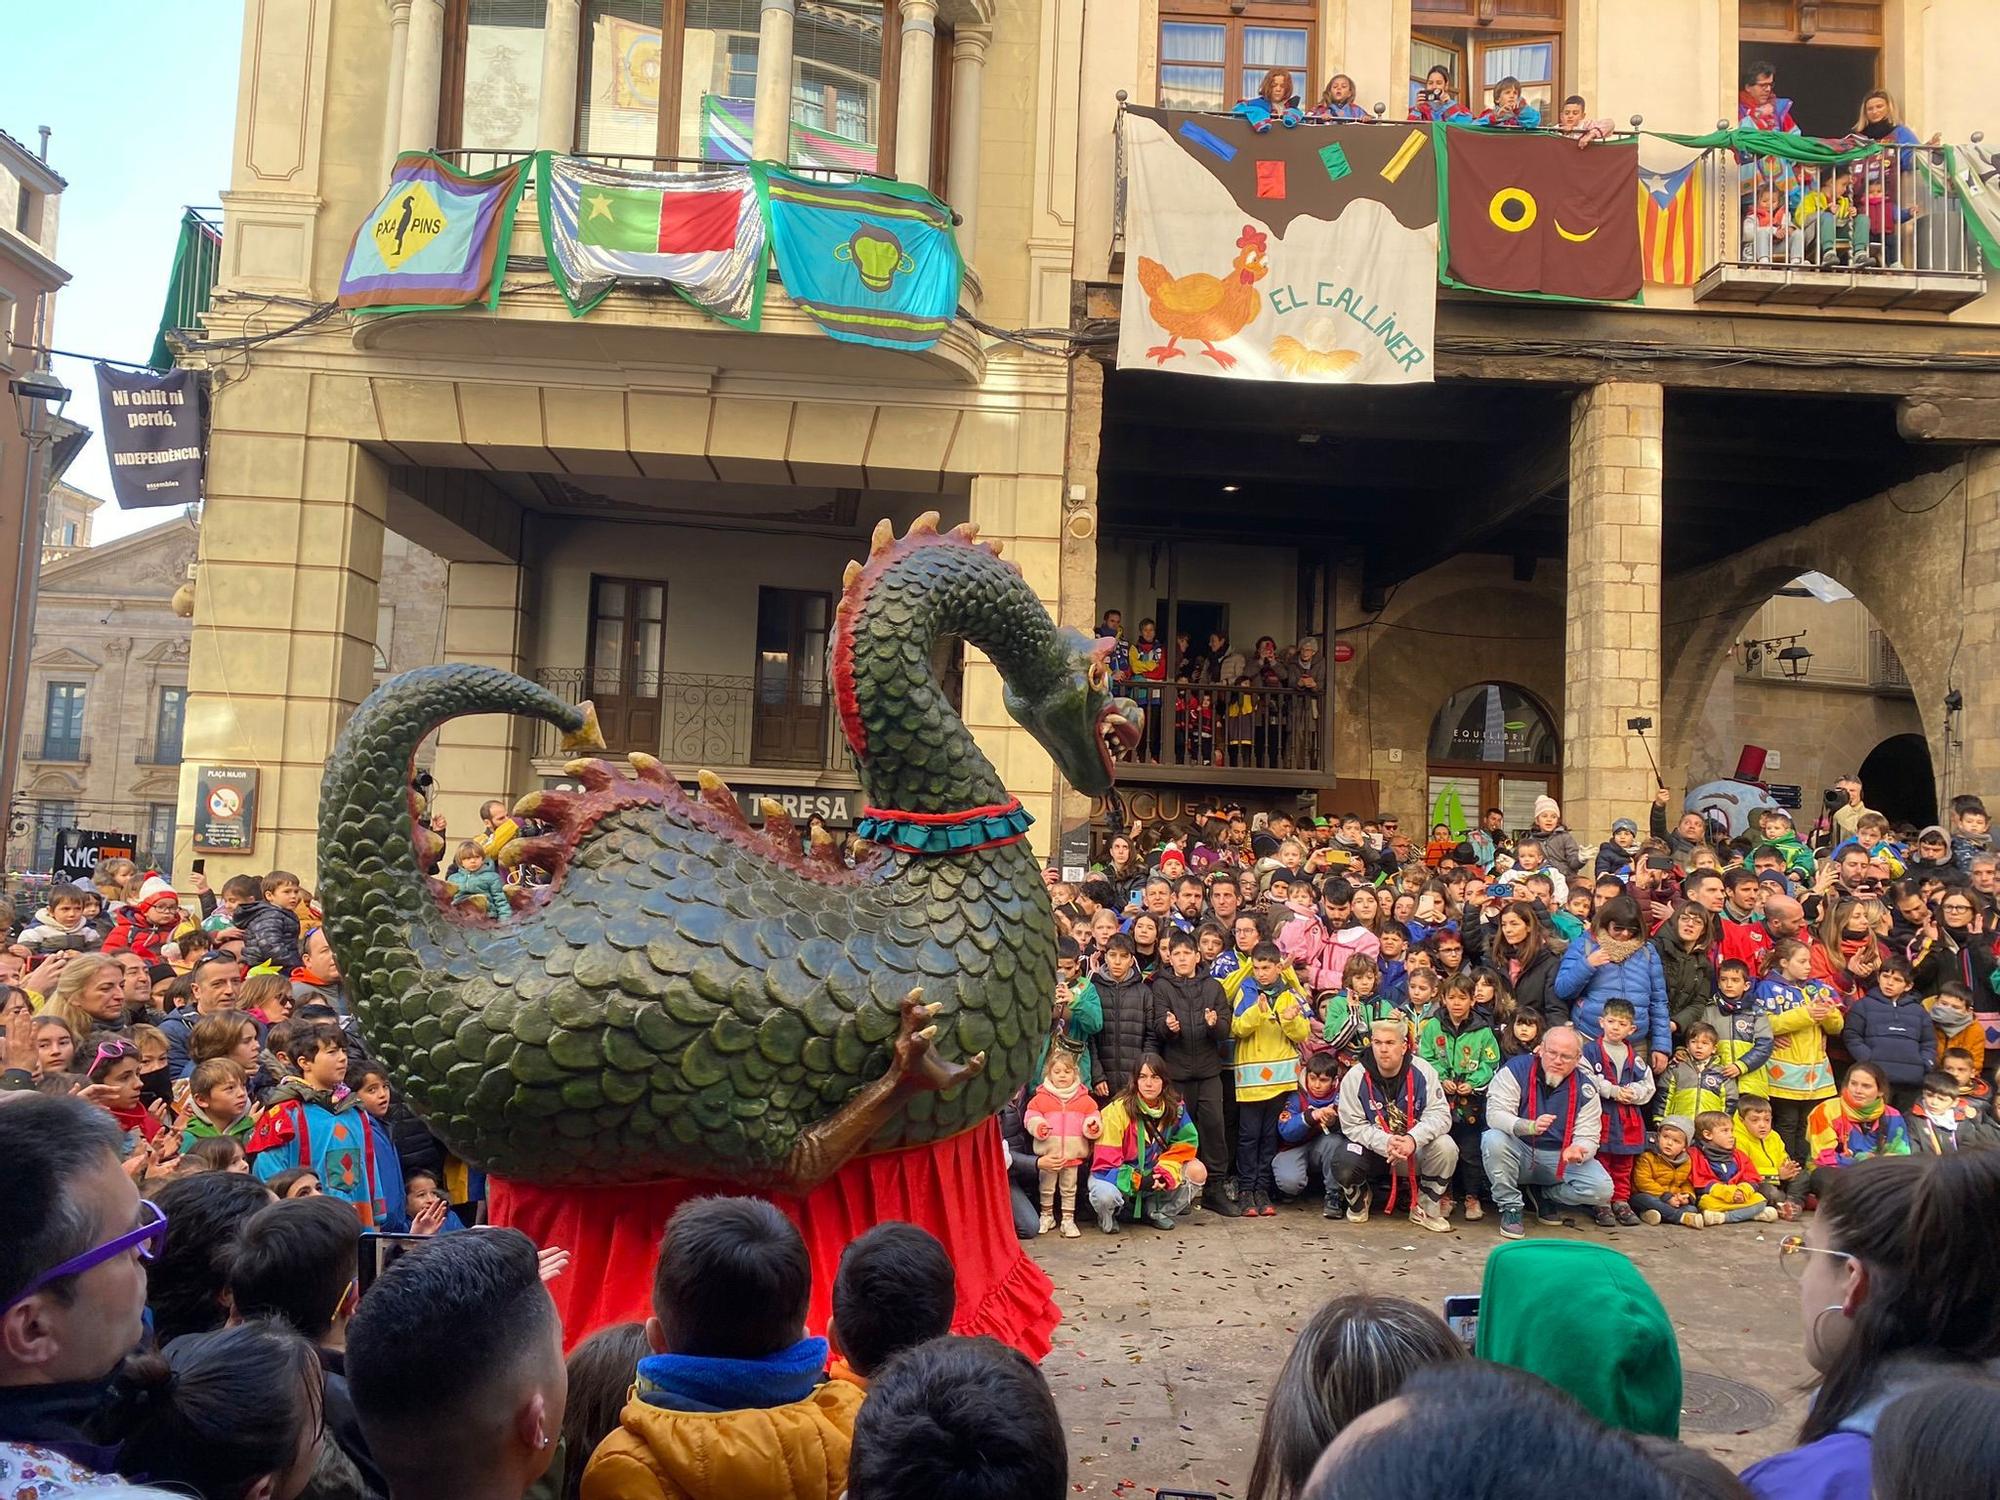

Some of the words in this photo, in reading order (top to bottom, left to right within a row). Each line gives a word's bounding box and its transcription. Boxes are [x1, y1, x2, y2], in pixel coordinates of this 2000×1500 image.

[410, 218, 442, 234] PINS
[1268, 284, 1309, 315] EL
[112, 390, 129, 406] Ni
[131, 390, 168, 405] oblit
[169, 389, 184, 405] ni
[127, 410, 177, 428] perdó,
[114, 447, 200, 466] INDEPENDÈNCIA
[1453, 729, 1525, 741] EQUILIBRI
[207, 770, 227, 778] PLAÇA
[748, 793, 849, 820] TRESA
